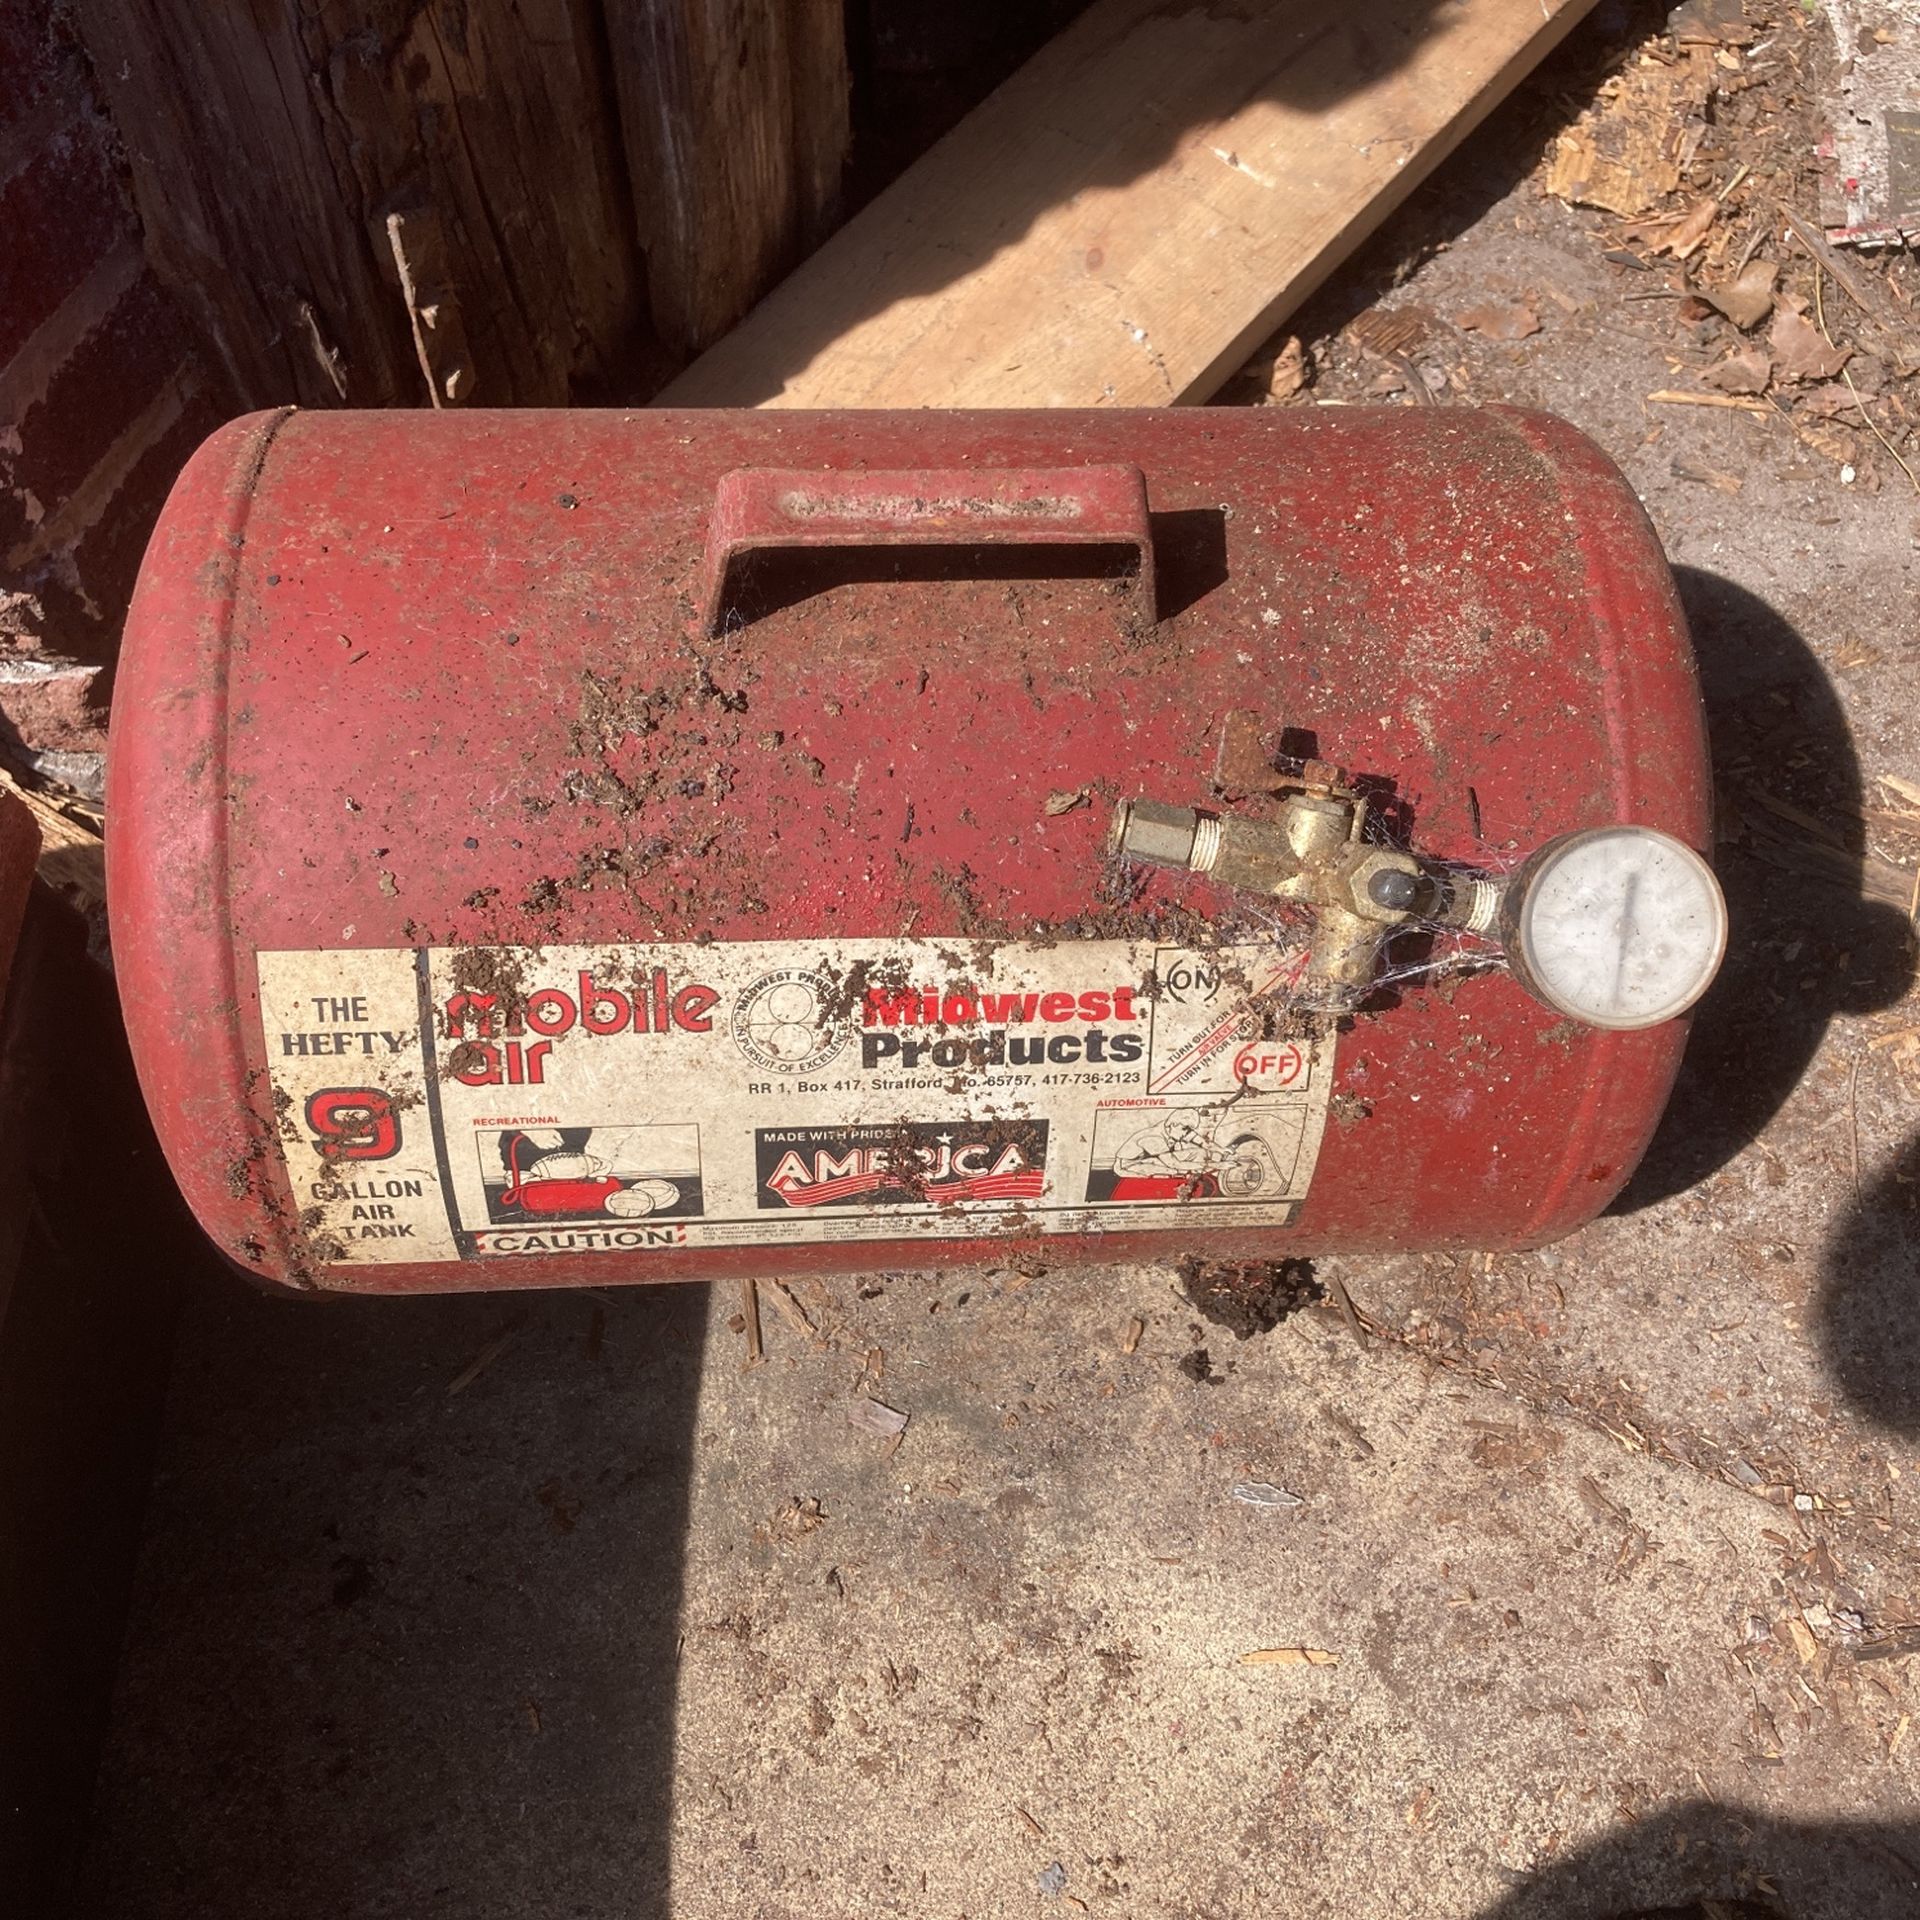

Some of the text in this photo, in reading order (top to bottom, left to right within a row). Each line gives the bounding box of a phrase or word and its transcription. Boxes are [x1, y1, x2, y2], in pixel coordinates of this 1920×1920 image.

[1172, 968, 1213, 990] ON
[311, 996, 369, 1023] THE
[446, 967, 722, 1039] mobile
[863, 985, 1138, 1028] Midwest
[281, 1031, 406, 1056] HEFTY
[1167, 1009, 1232, 1064] TURN OUT FOR
[1209, 1023, 1233, 1045] VALVE
[741, 1037, 776, 1069] PURSUIT
[778, 1062, 795, 1073] OF
[799, 1022, 849, 1072] EXCELLENCE
[861, 1030, 1144, 1069] Products
[450, 1040, 553, 1086] air
[1175, 1063, 1202, 1086] TURN
[1199, 1054, 1213, 1068] IN
[1211, 1040, 1232, 1059] FOR
[1238, 1055, 1297, 1076] OFF
[749, 1083, 772, 1094] RR
[778, 1083, 791, 1095] 1,
[798, 1081, 828, 1093] Box
[834, 1079, 866, 1092] 417,
[871, 1077, 943, 1090] Strafford
[987, 1074, 1037, 1087] 65757,
[1042, 1072, 1141, 1085] 417-736-2123
[1096, 1098, 1167, 1108] AUTOMOTIVE
[304, 1087, 403, 1161] 9
[472, 1115, 562, 1126] RECREATIONAL
[764, 1131, 806, 1142] MADE
[809, 1130, 847, 1141] WITH
[311, 1180, 423, 1200] GALLON
[352, 1204, 396, 1220] AIR
[340, 1224, 417, 1239] TANK
[493, 1231, 674, 1250] CAUTION
